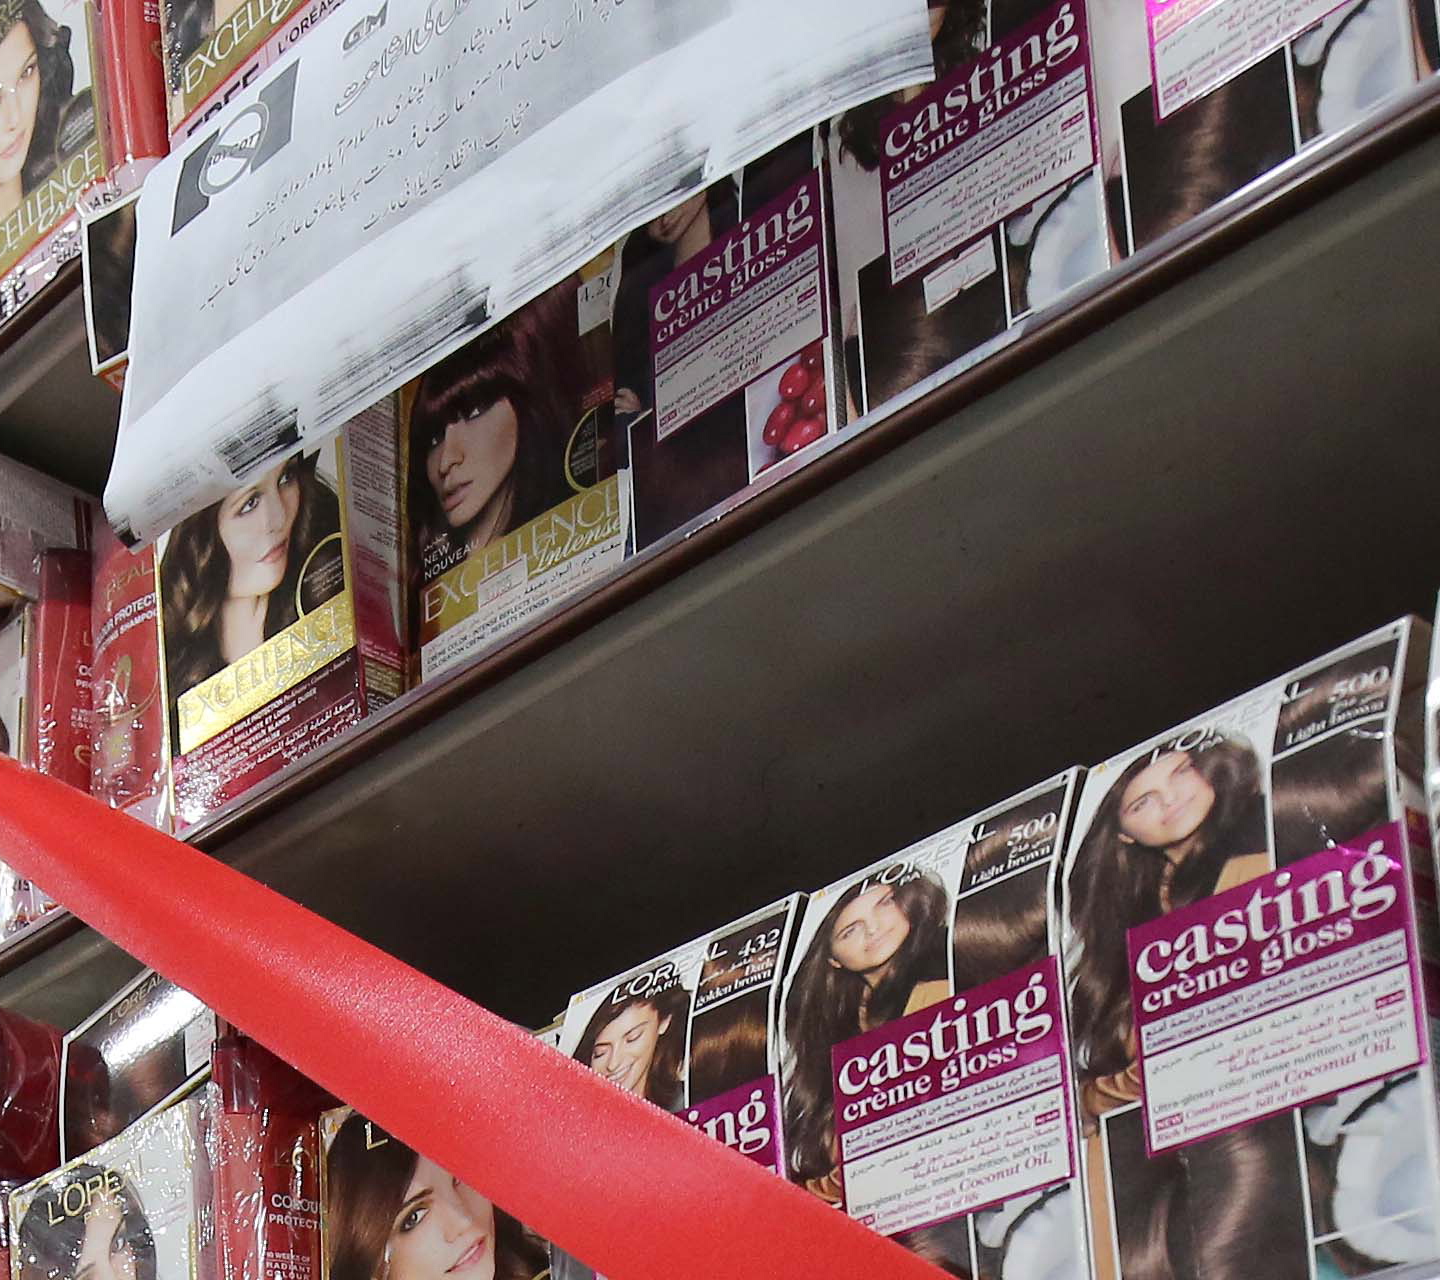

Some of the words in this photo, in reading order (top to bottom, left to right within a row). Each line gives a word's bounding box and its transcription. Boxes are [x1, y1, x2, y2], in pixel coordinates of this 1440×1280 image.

[885, 2, 1080, 158] casting
[887, 117, 969, 180] crème
[978, 68, 1048, 129] gloss
[655, 185, 814, 322] casting
[656, 288, 723, 344] crème
[730, 243, 788, 297] gloss
[424, 543, 450, 566] NEW
[424, 540, 480, 582] NOUVEAU
[1328, 665, 1391, 704] 500
[1006, 813, 1056, 848] 500
[970, 863, 1005, 886] Light
[1135, 839, 1398, 983] casting
[736, 927, 782, 960] 432
[1142, 952, 1250, 1013] crème
[1259, 916, 1356, 976] gloss
[838, 972, 1053, 1096] casting
[842, 1071, 933, 1123] crème
[940, 1039, 1018, 1093] gloss
[1155, 1112, 1185, 1132] NEW
[1284, 1055, 1358, 1087] Coconut
[266, 1261, 311, 1274] RADIANT
